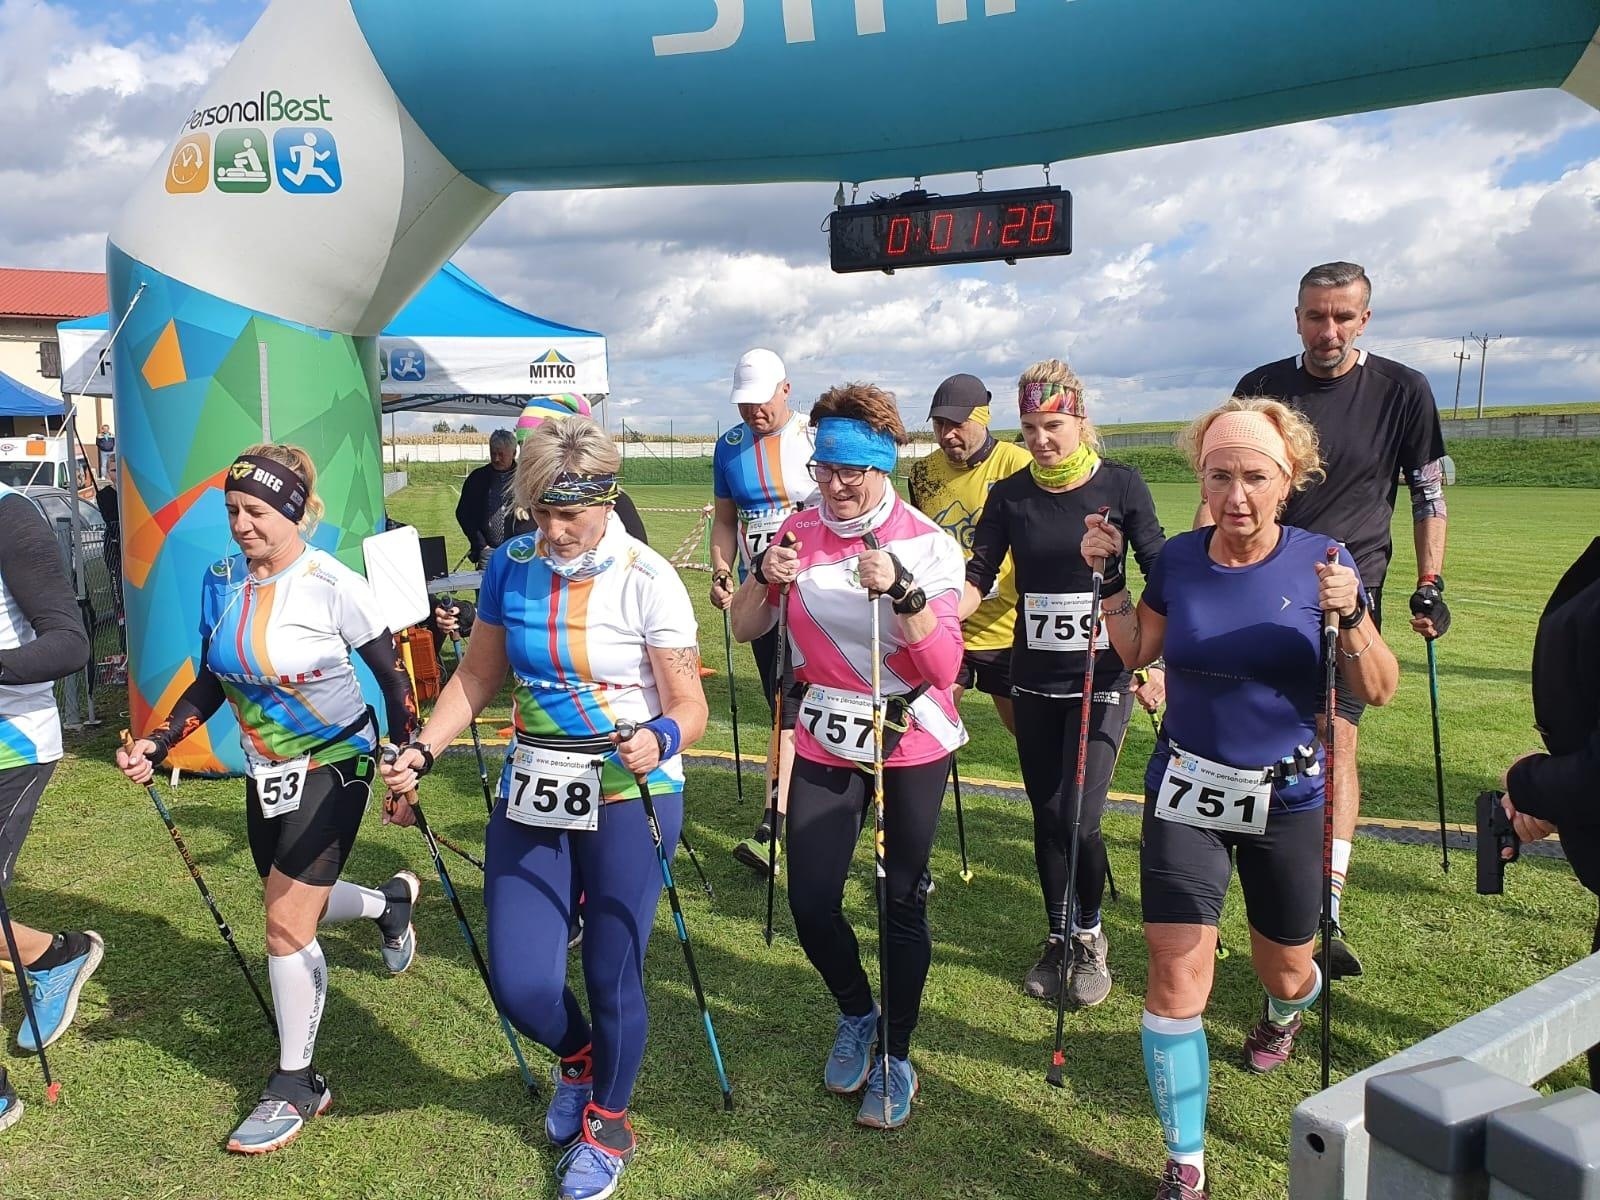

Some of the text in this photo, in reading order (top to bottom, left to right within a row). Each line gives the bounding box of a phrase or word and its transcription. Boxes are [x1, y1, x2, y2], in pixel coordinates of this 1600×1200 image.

[887, 203, 1056, 254] 0:01:28
[530, 364, 576, 379] MITKO
[252, 467, 284, 493] BIEG
[1030, 613, 1102, 641] 759
[803, 707, 874, 749] 757
[263, 772, 300, 806] 53
[513, 771, 591, 817] 758
[1167, 775, 1256, 823] 751
